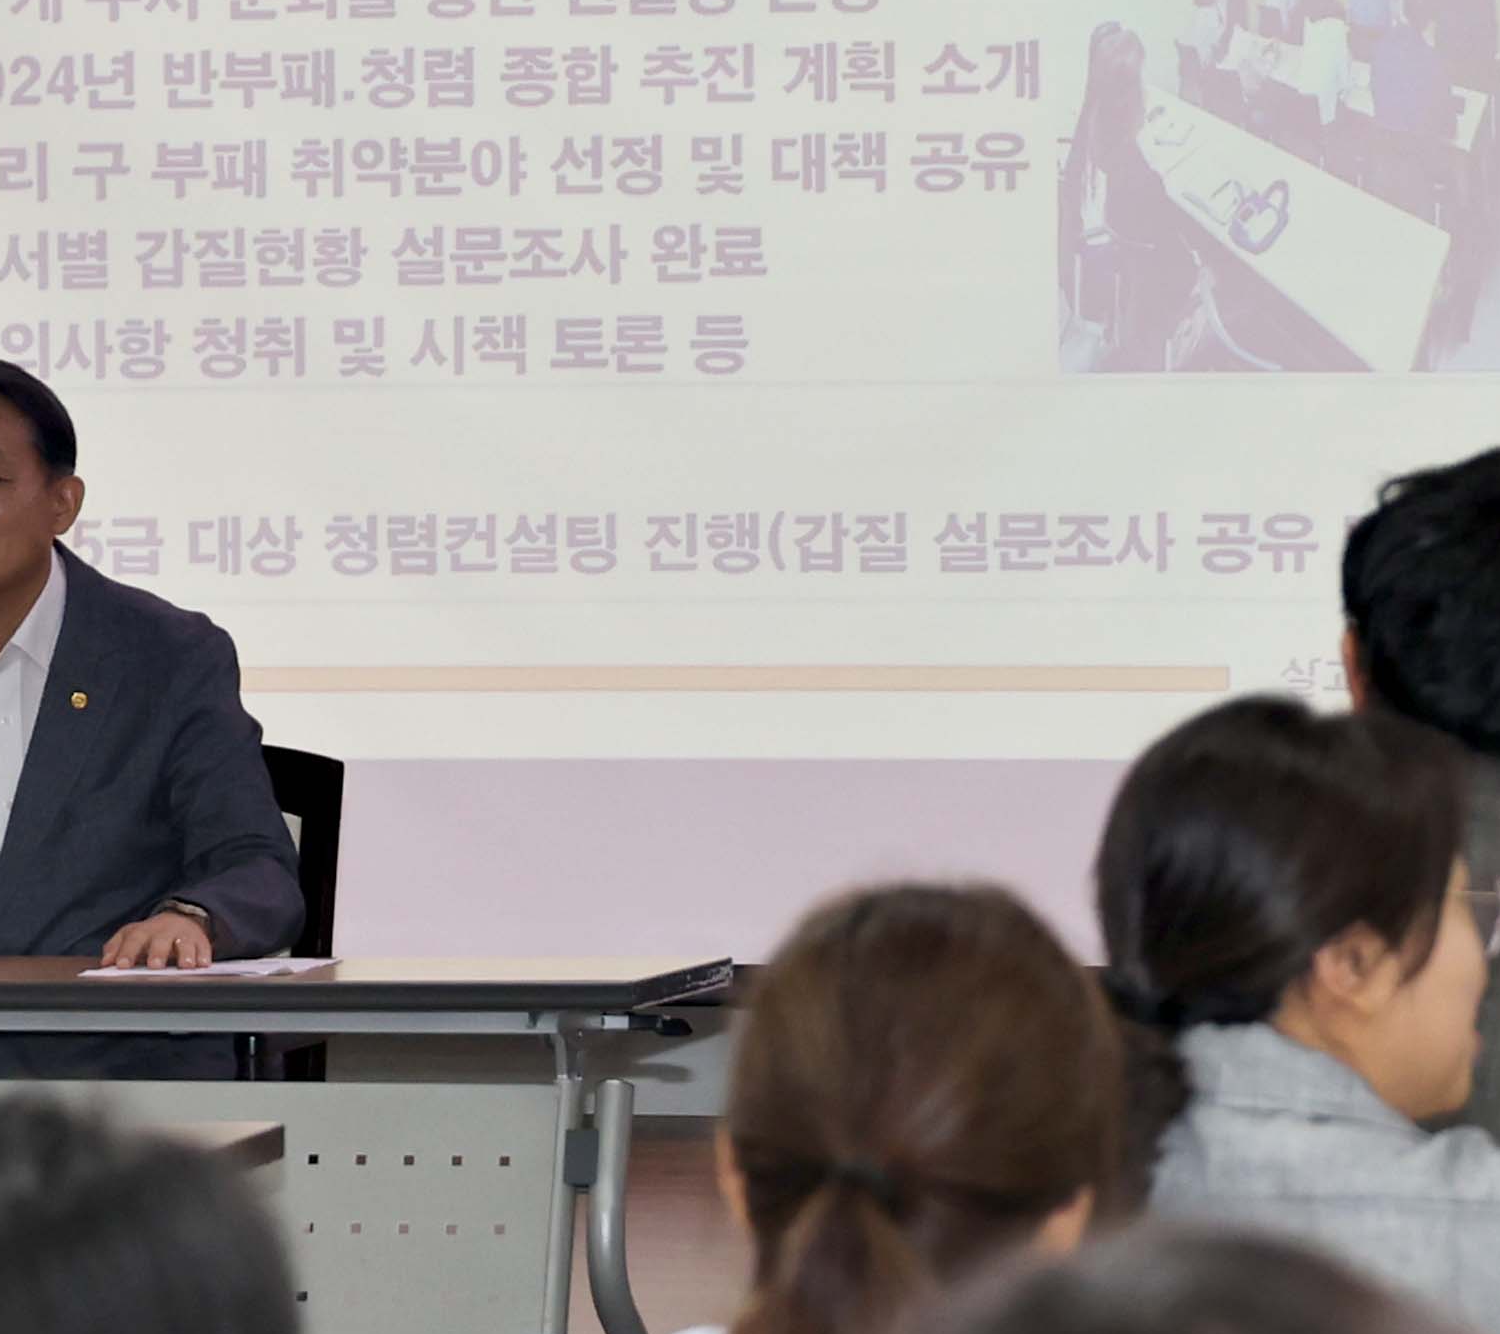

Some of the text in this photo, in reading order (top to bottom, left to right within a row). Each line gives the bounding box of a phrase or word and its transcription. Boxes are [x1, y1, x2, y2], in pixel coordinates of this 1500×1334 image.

[162, 45, 476, 110] 반부패.청렴
[499, 44, 620, 109] 종합
[639, 41, 756, 107] 추진
[782, 40, 897, 104] 계획
[920, 38, 1041, 101] 소개
[71, 141, 132, 203] 구
[150, 138, 268, 201] 부패
[290, 135, 528, 199] 취약분야
[549, 133, 664, 198] 선정
[690, 132, 745, 197] 및
[770, 130, 888, 195] 대책
[909, 131, 1031, 194] 공유
[134, 226, 369, 291] 갑질현황
[390, 223, 629, 287] 설문조사
[649, 222, 769, 284] 완료
[192, 315, 307, 380] 청취
[332, 315, 388, 379] 및
[409, 313, 528, 377] 시책
[549, 314, 669, 375] 토론
[689, 314, 750, 376] 등
[187, 514, 304, 578] 대상
[324, 511, 619, 577] 청렴컨설팅
[643, 509, 908, 576] 진행(갑질
[932, 511, 1176, 574] 설문조사
[1195, 512, 1320, 575] 공유
